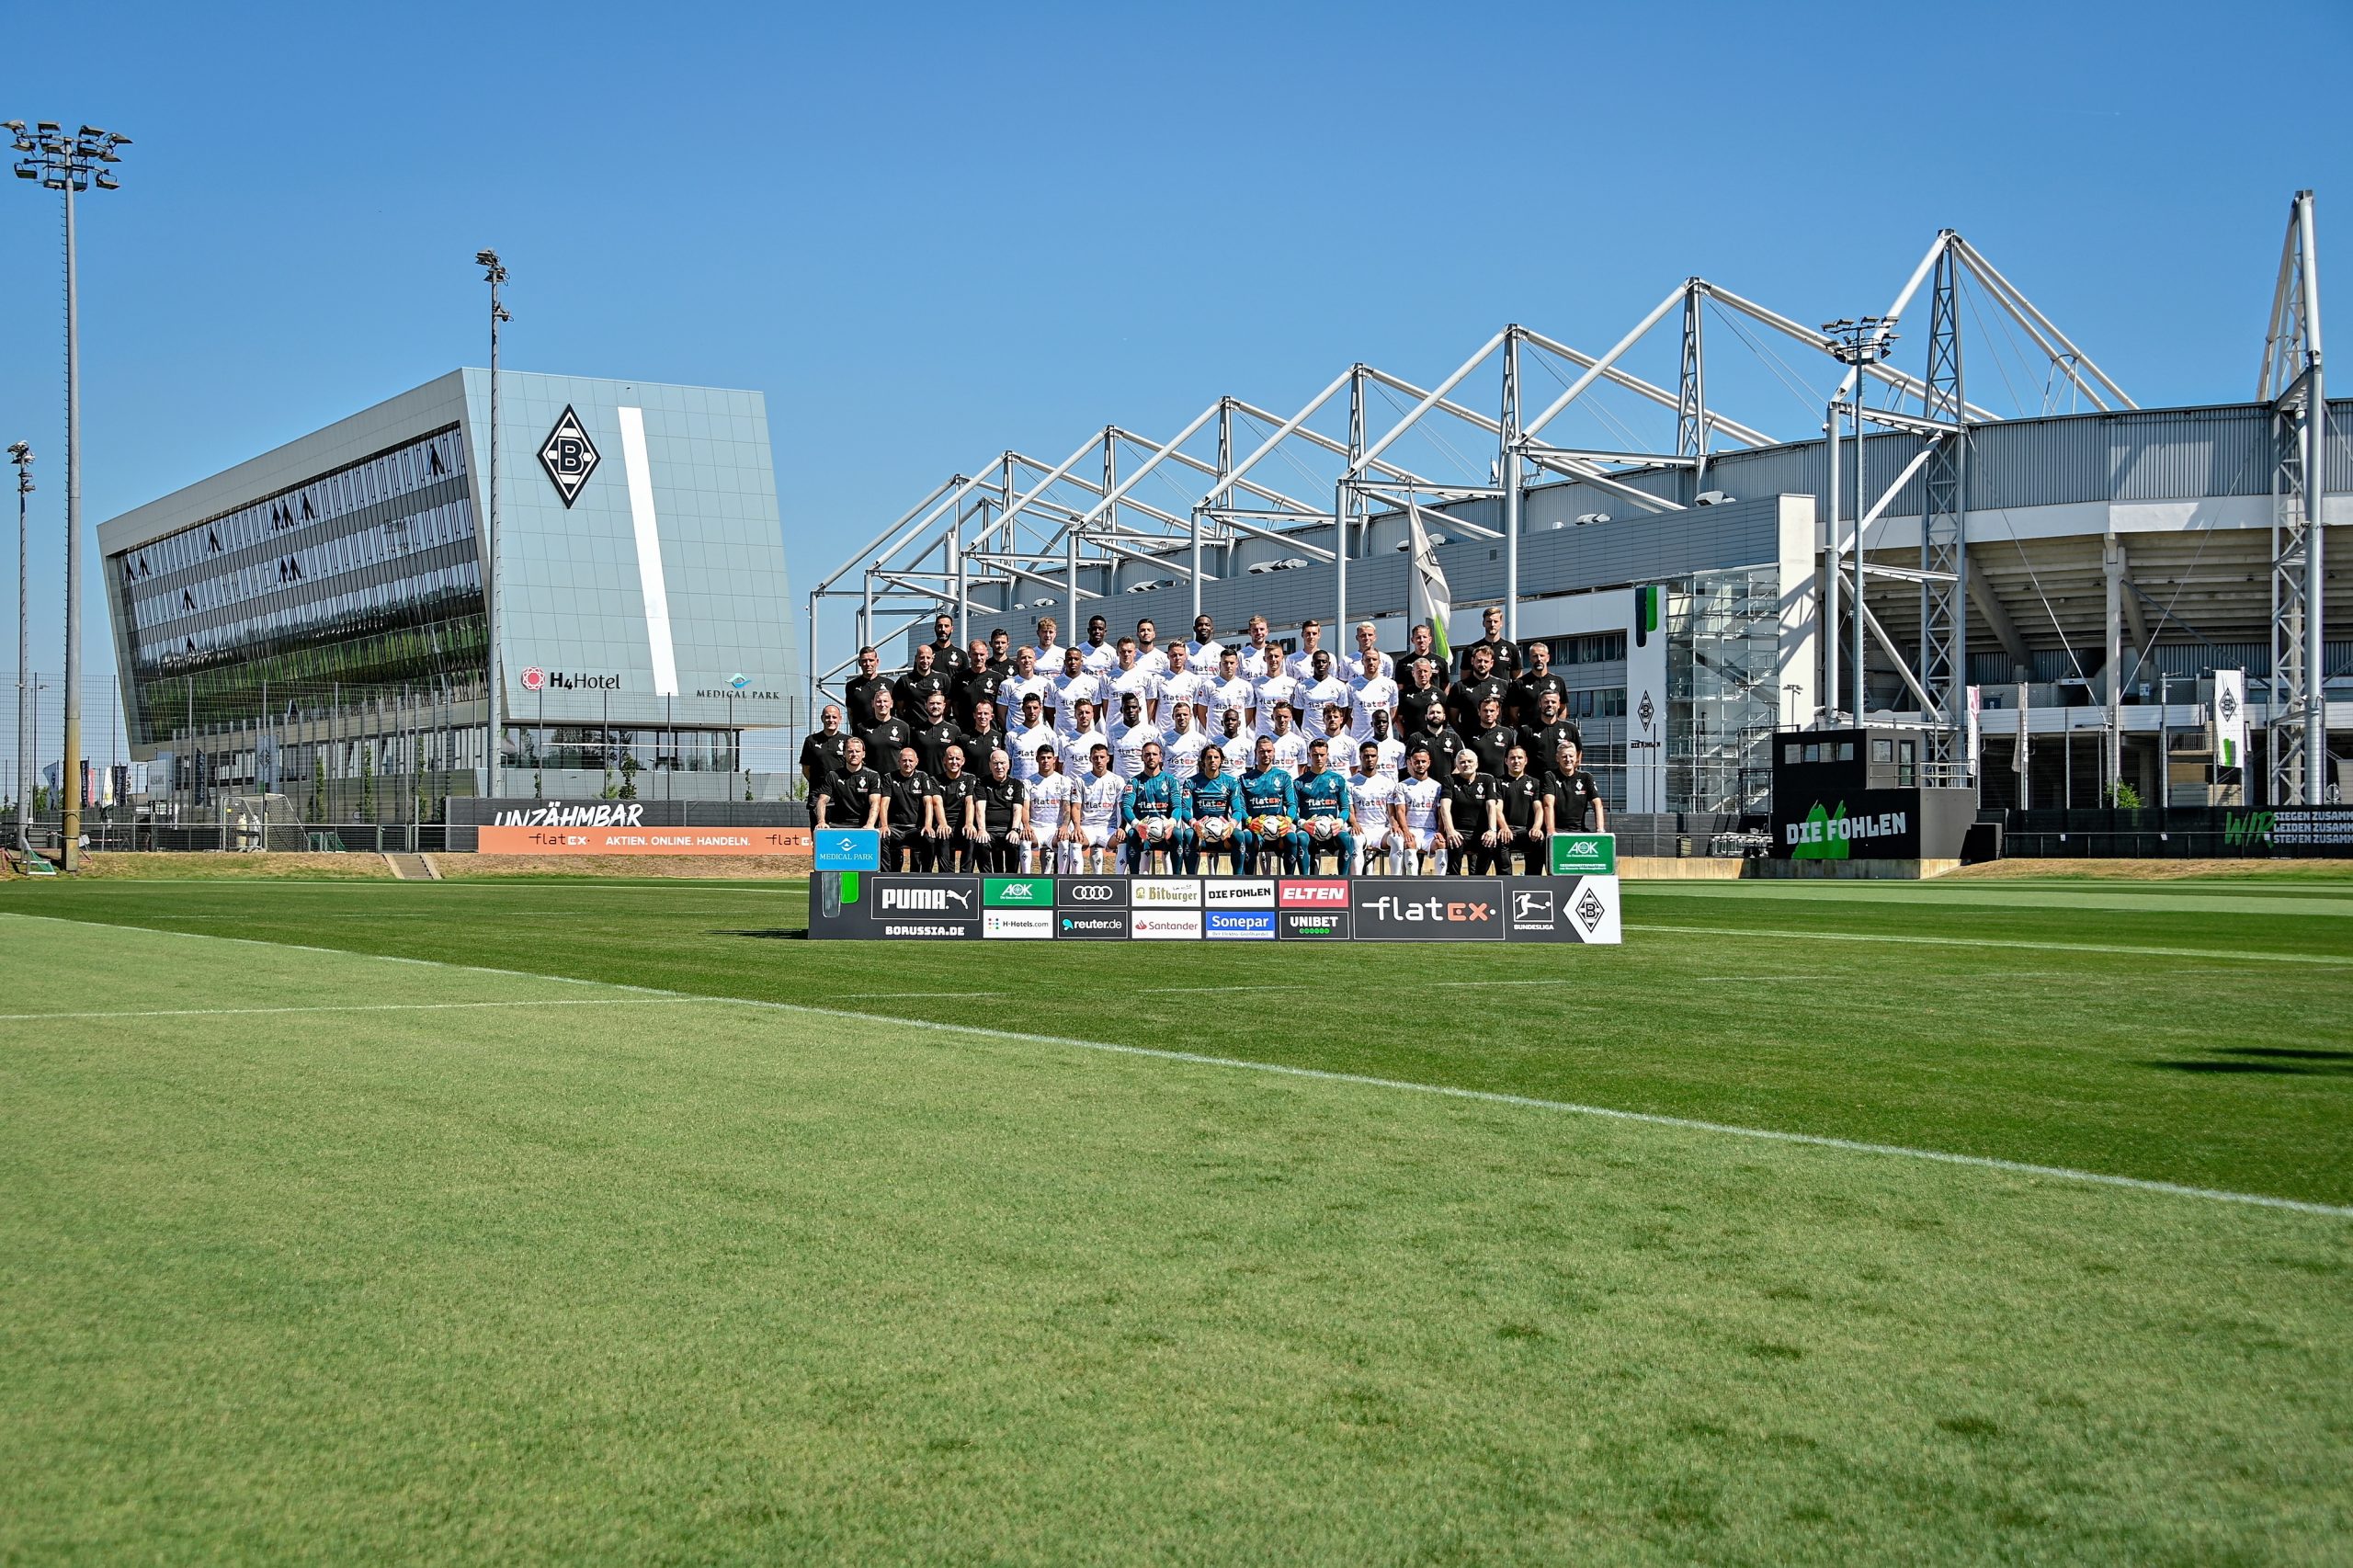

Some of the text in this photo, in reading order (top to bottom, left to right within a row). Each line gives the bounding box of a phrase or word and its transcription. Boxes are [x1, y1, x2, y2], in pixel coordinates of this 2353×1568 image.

[558, 437, 584, 474] B
[550, 672, 620, 690] H4Hotel
[696, 689, 780, 699] MEDICAL PARK
[494, 801, 643, 827] UNZÄHMBAR
[2273, 811, 2353, 821] SIEGEN ZUSAMM
[1786, 812, 1906, 845] DIE FOHLEN
[2224, 811, 2275, 848] WIR
[2273, 823, 2353, 833] LEIDEN ZUSAMM
[606, 836, 648, 846] AKTIEN.
[651, 836, 693, 846] ONLINE.
[697, 836, 751, 846] HANDELN.
[2273, 834, 2353, 844] STEHEN ZUSAMM
[1567, 841, 1598, 854] AOK
[1002, 883, 1033, 896] AOK
[1148, 886, 1198, 903] Bitburger
[1209, 888, 1271, 900] DIE FOHLEN
[1282, 888, 1345, 900] ELTEN
[1074, 919, 1122, 929] reuter.de
[1149, 921, 1198, 930] Santander
[1211, 915, 1269, 930] Sonepar
[1290, 915, 1338, 927] UNIBET
[885, 926, 965, 937] BORUSSIA.DE
